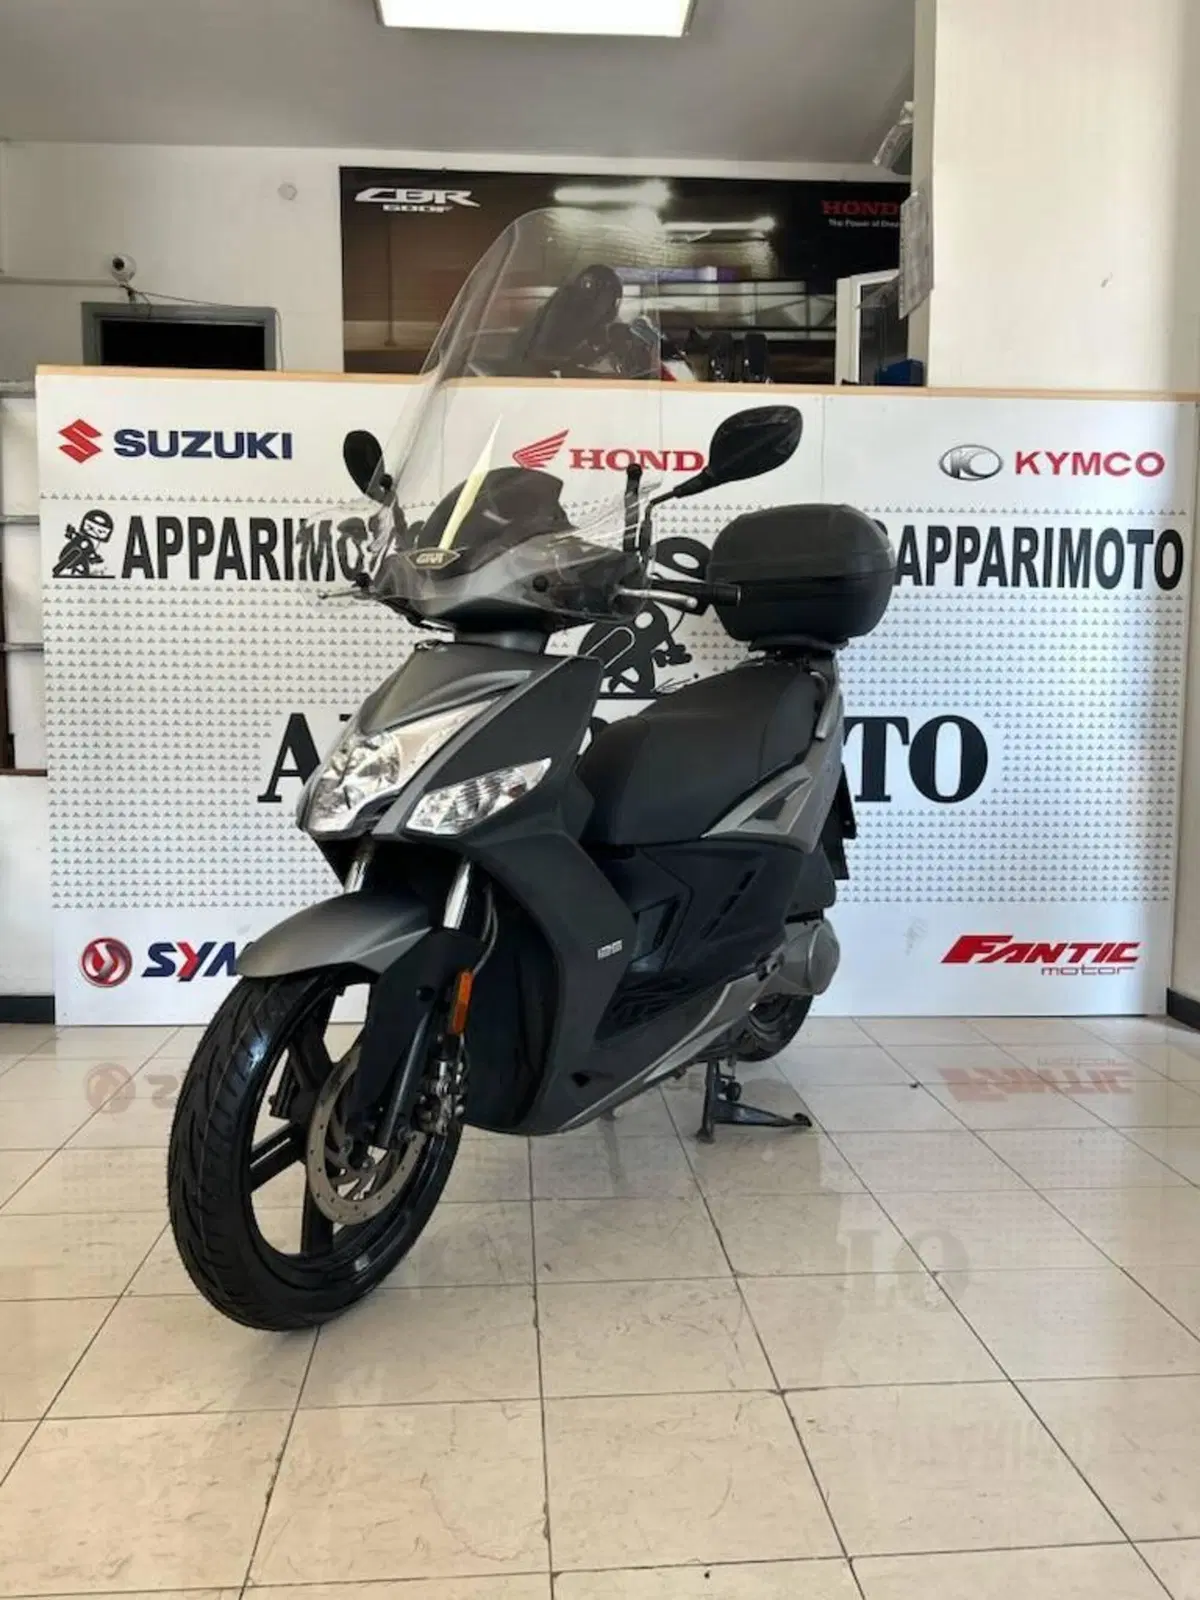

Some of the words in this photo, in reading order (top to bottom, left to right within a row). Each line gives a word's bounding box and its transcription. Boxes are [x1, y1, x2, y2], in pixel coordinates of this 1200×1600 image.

[354, 186, 480, 207] CBR
[821, 200, 899, 216] HOND
[113, 428, 293, 460] SUZUKI
[568, 448, 705, 471] HOND
[1014, 450, 1166, 477] KYMCO
[121, 515, 426, 583] APPARIMO
[894, 524, 1184, 591] APPARIMOTO
[941, 934, 1140, 963] FANTIC
[1041, 963, 1134, 976] motor
